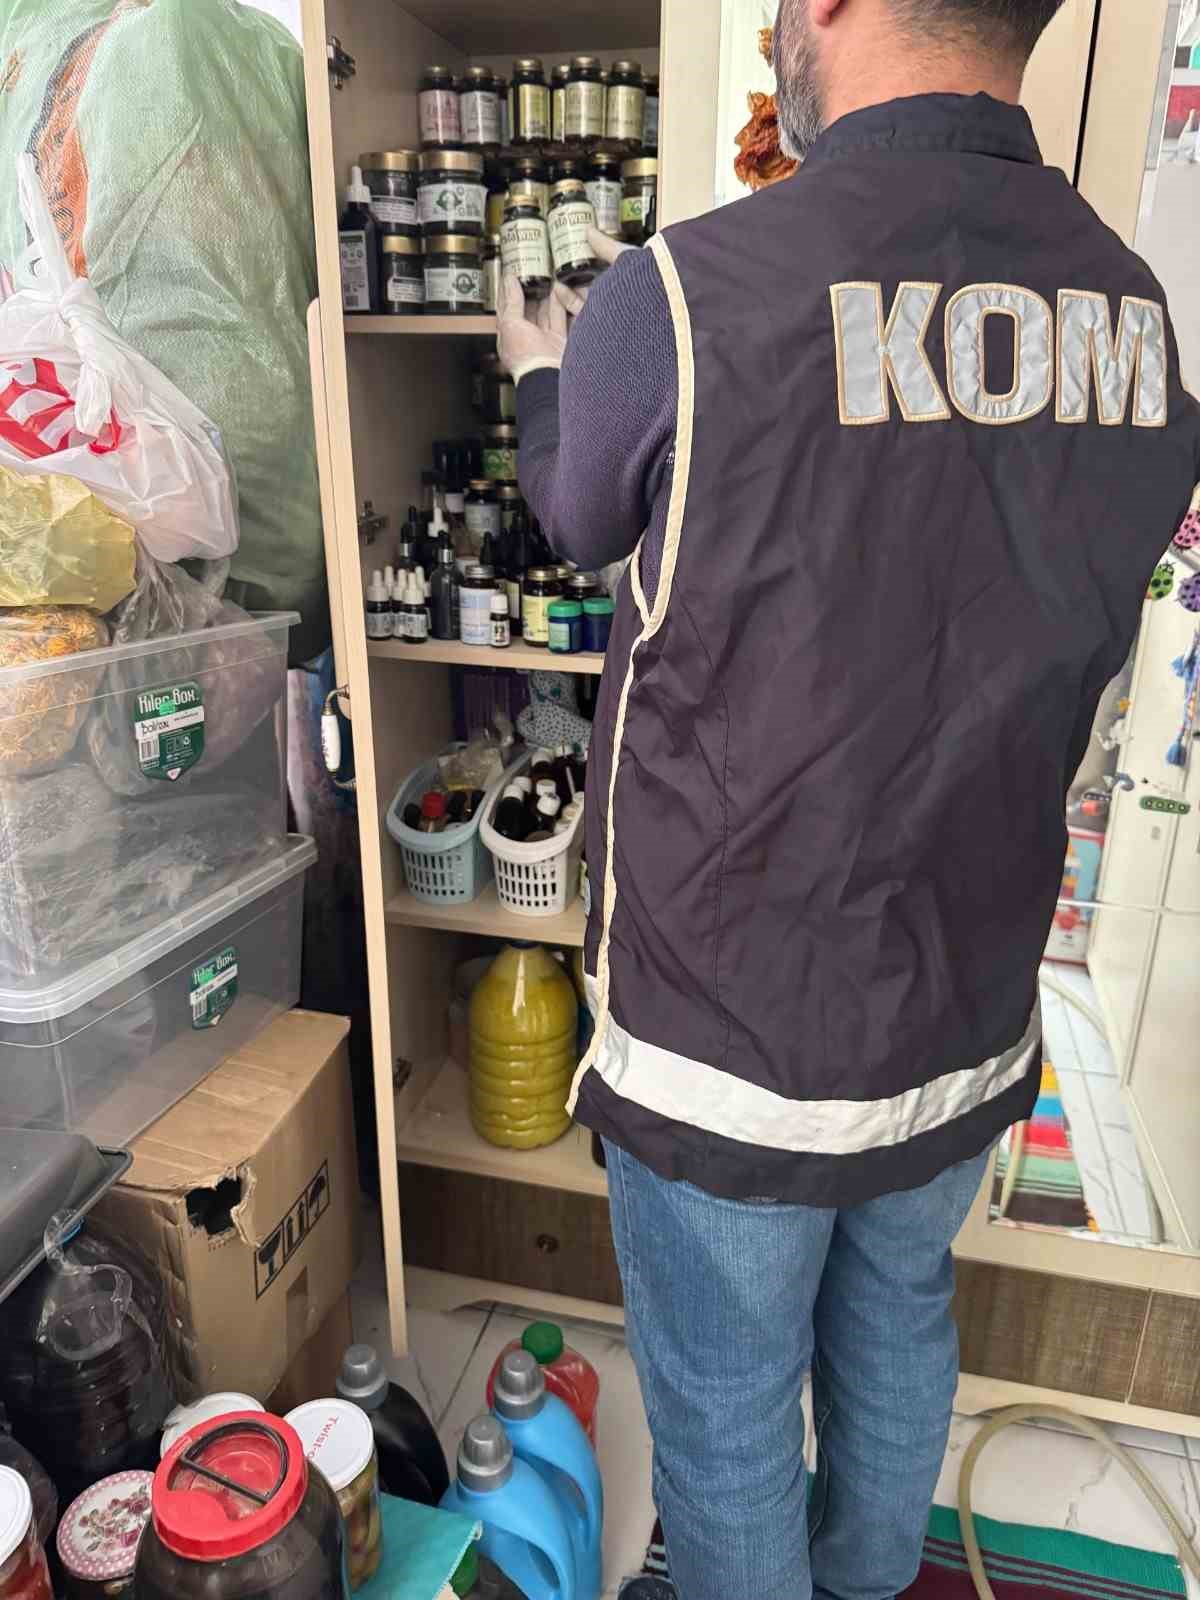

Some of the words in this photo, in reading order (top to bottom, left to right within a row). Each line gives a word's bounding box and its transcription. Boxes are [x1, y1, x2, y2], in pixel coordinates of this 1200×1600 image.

[829, 281, 1167, 428] KOM
[172, 688, 196, 705] Box
[305, 1415, 338, 1460] Twist-o
